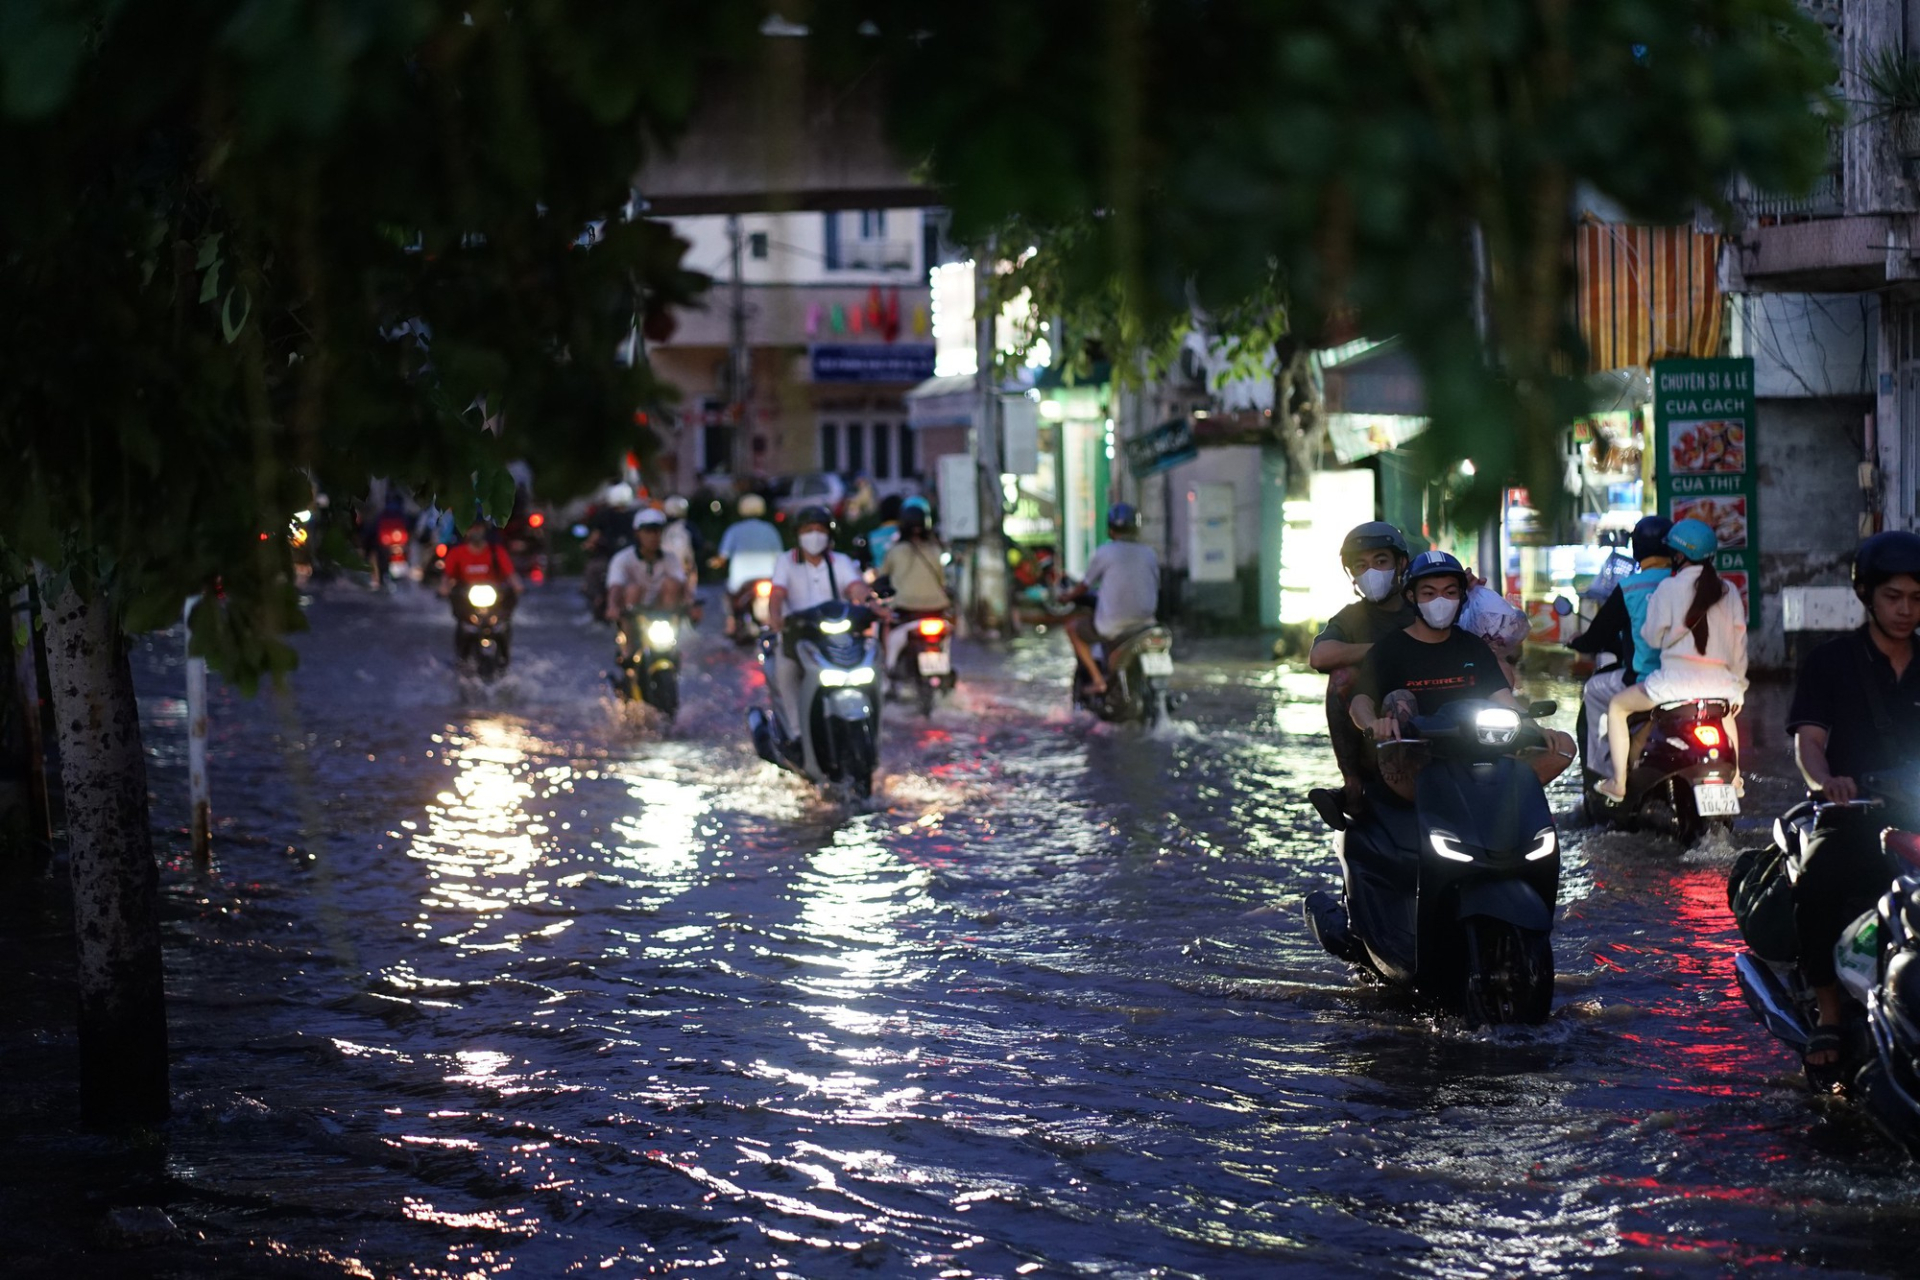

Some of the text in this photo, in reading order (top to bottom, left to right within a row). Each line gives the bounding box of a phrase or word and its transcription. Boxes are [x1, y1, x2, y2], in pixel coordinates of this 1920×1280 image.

[1723, 371, 1732, 391] &
[1665, 398, 1698, 415] CUA
[1671, 476, 1705, 492] CUA
